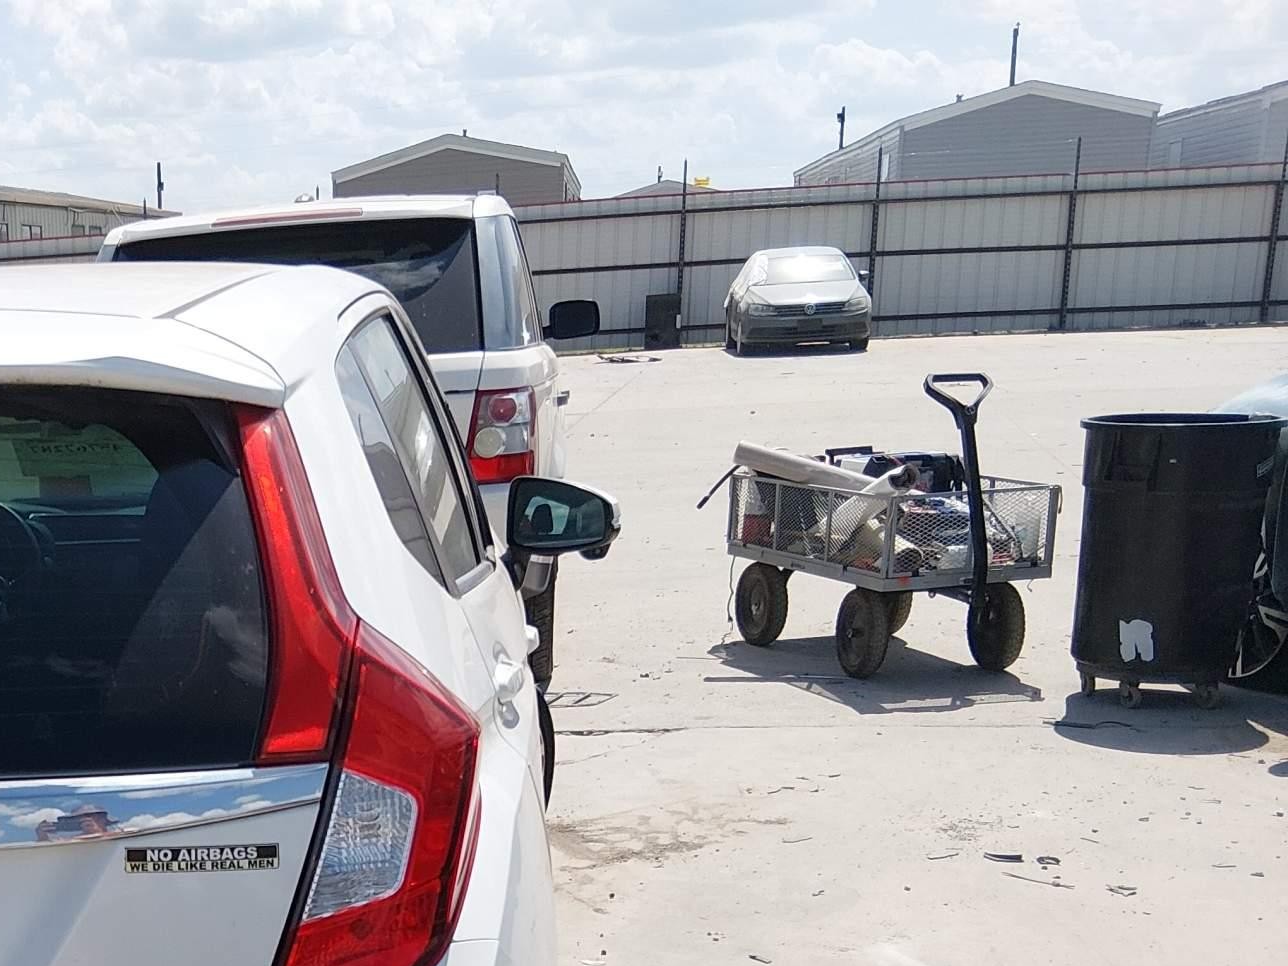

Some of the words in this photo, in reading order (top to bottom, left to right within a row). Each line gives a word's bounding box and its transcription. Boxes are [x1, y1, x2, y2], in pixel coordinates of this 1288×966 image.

[146, 849, 172, 862] NO
[178, 846, 258, 861] AIRBAGS
[130, 862, 148, 871] WE
[152, 862, 173, 871] DIE
[177, 861, 206, 871] LIKE
[211, 860, 244, 870] REAL
[247, 859, 274, 869] MEN
